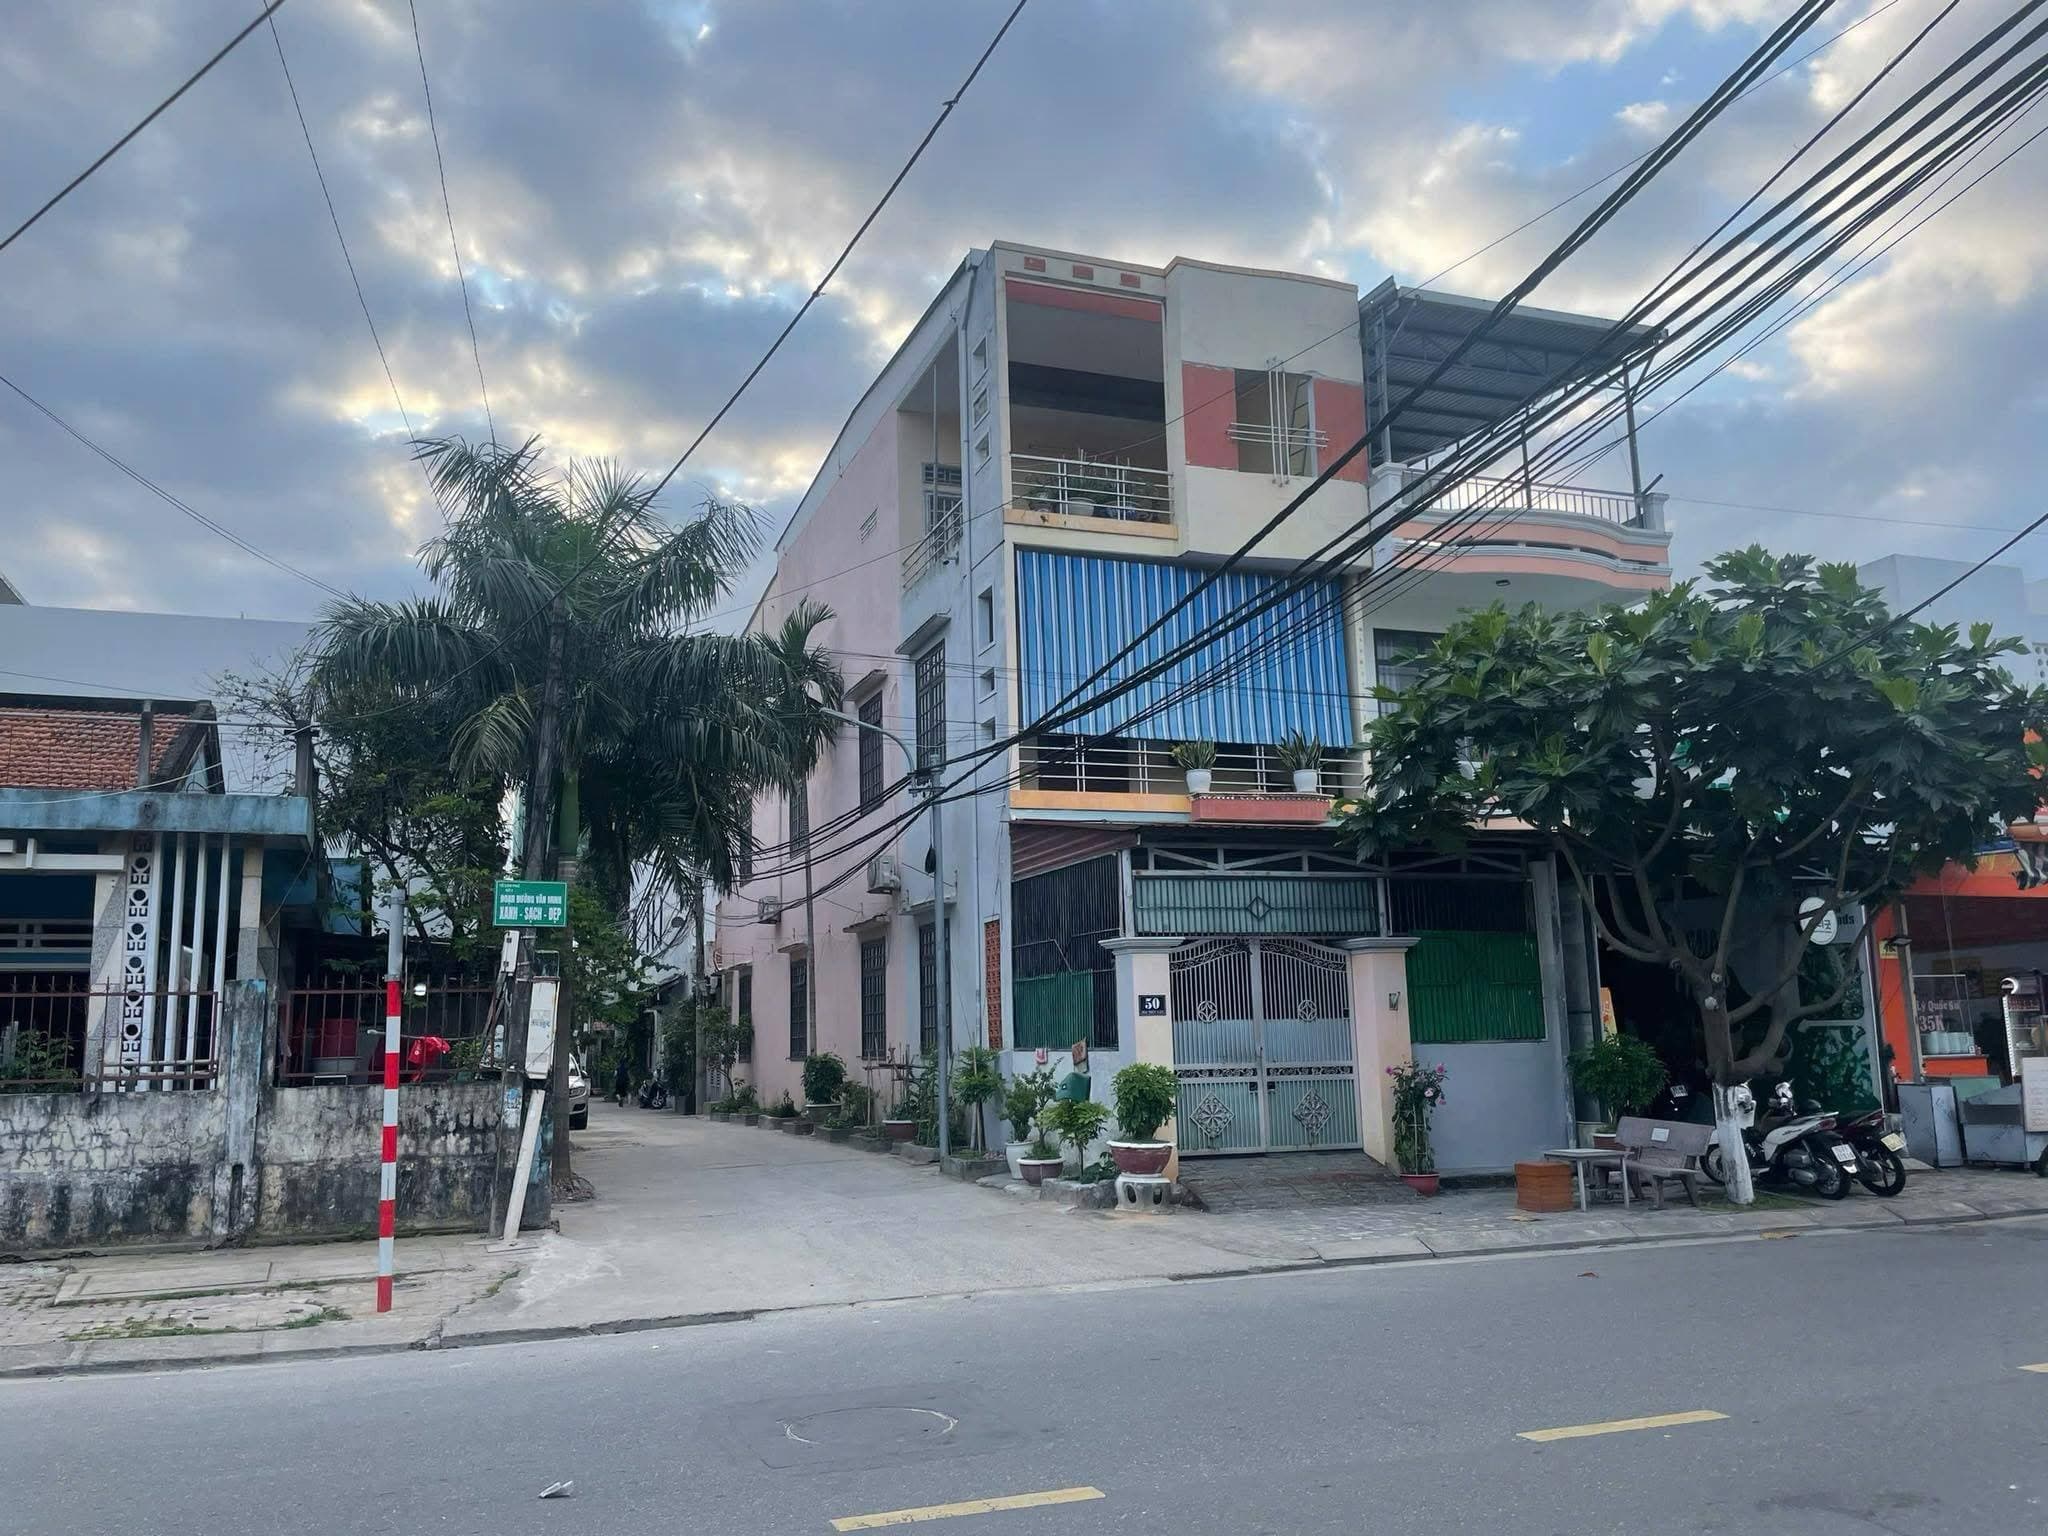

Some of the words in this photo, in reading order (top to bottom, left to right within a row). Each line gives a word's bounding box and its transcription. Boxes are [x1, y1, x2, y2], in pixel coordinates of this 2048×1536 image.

[499, 906, 518, 920] XANH
[524, 906, 543, 923] SẠCH
[548, 907, 562, 924] ĐẸP
[1145, 997, 1160, 1009] 50
[1919, 1014, 1945, 1032] 35K
